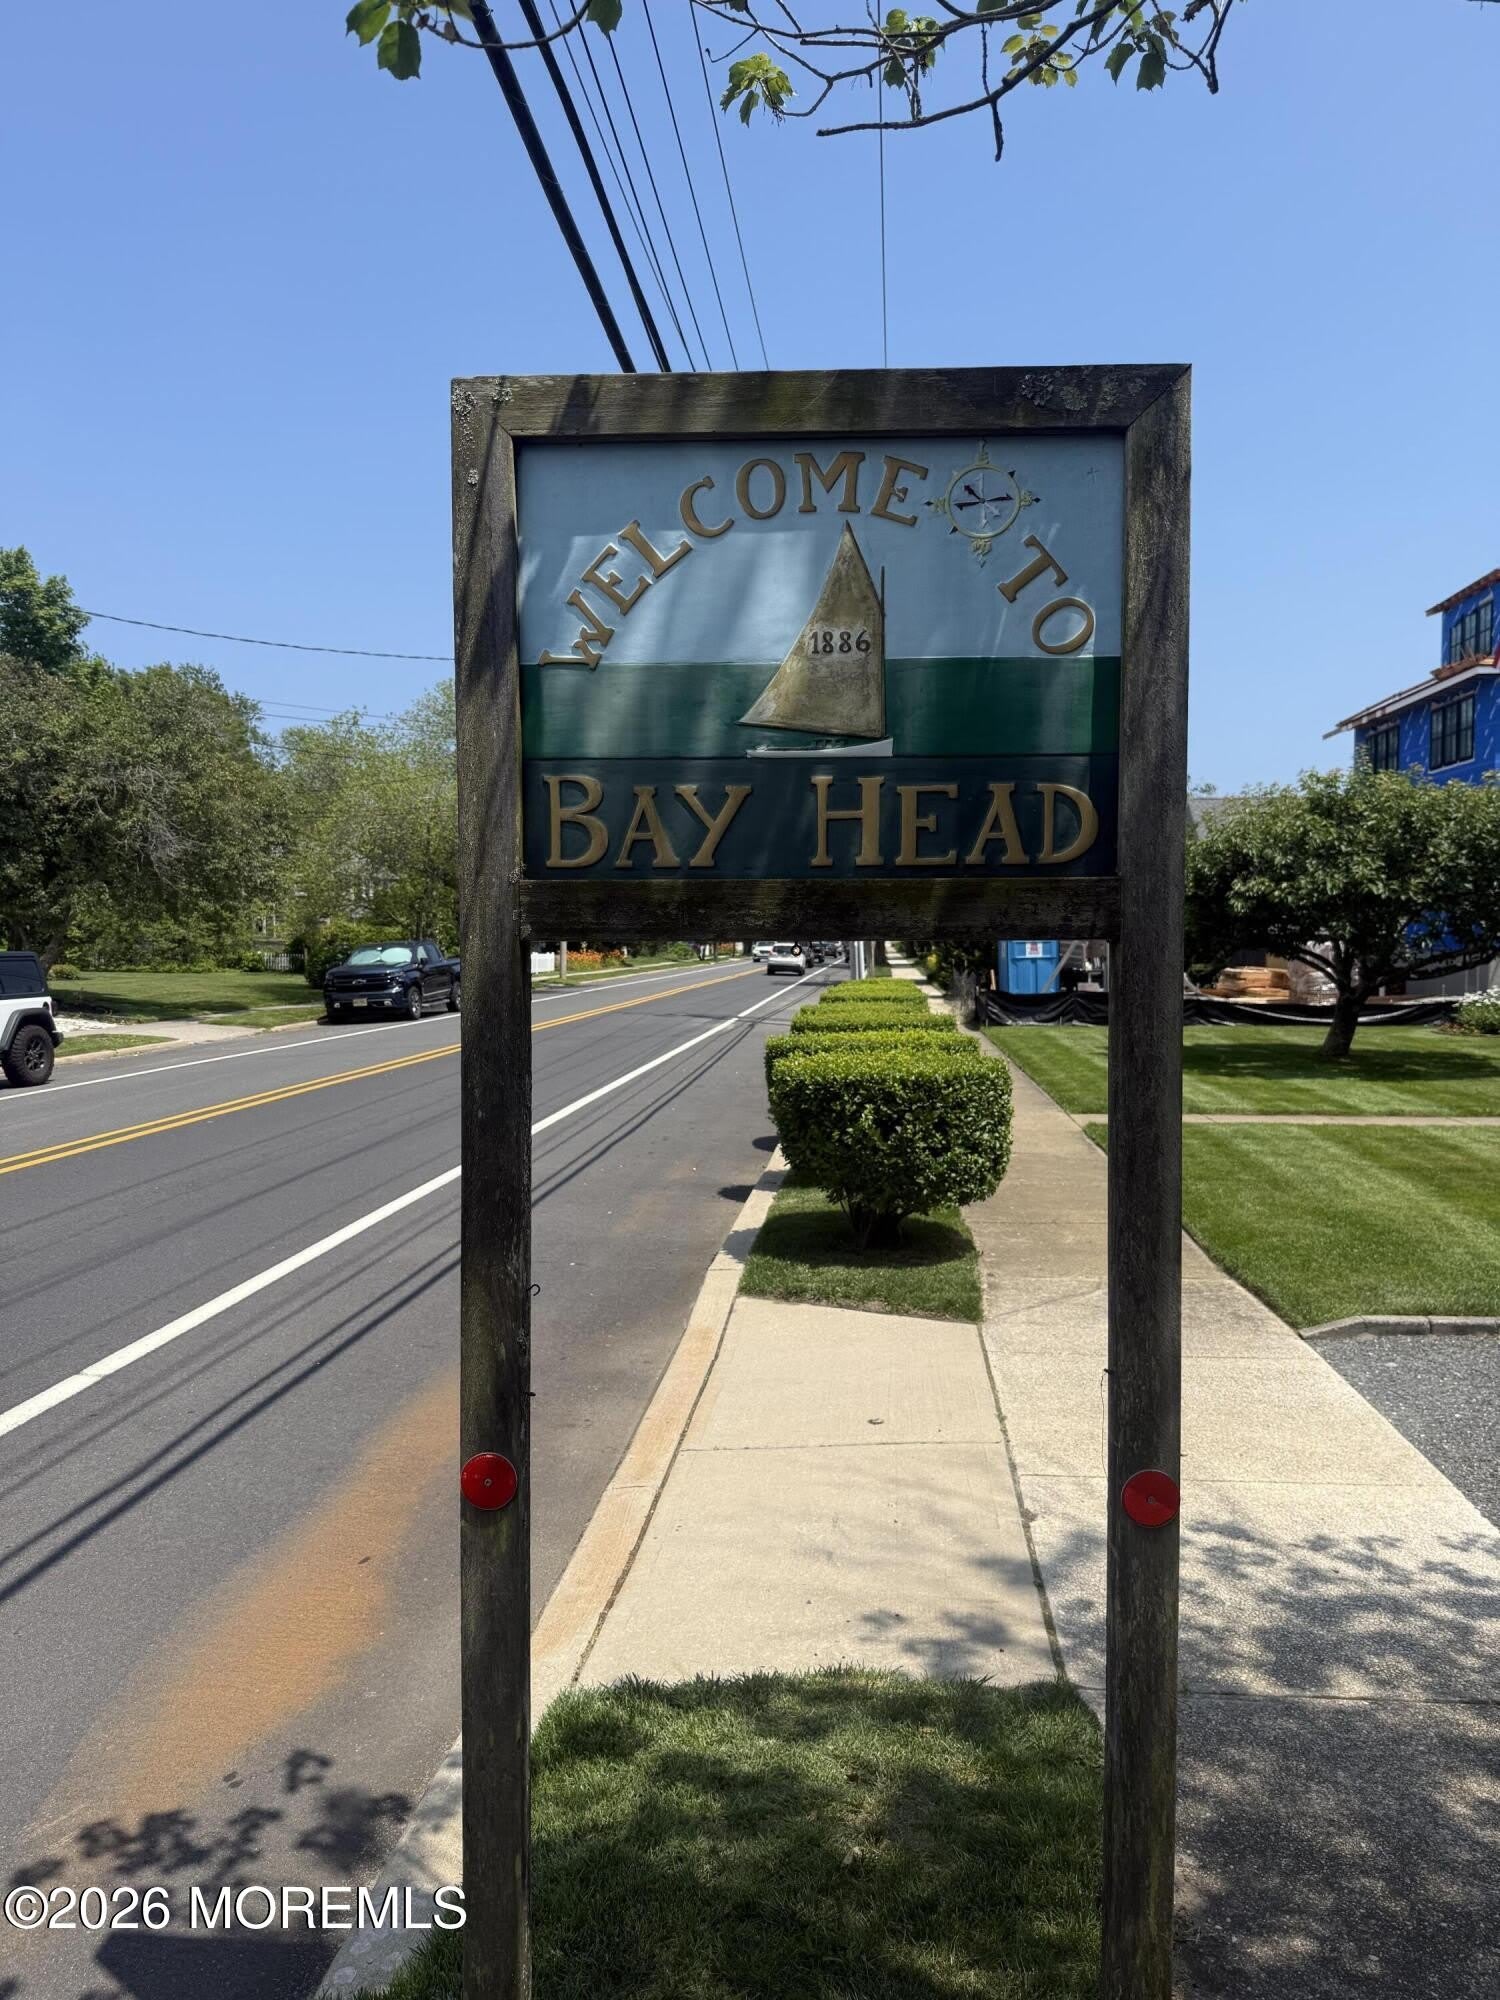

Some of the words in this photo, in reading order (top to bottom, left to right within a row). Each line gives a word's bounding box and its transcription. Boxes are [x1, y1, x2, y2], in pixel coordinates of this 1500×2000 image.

[538, 451, 929, 671] WELCOME
[997, 534, 1096, 655] TO
[810, 629, 871, 654] 1886
[543, 773, 752, 869] BAY
[809, 774, 1099, 868] HEAD
